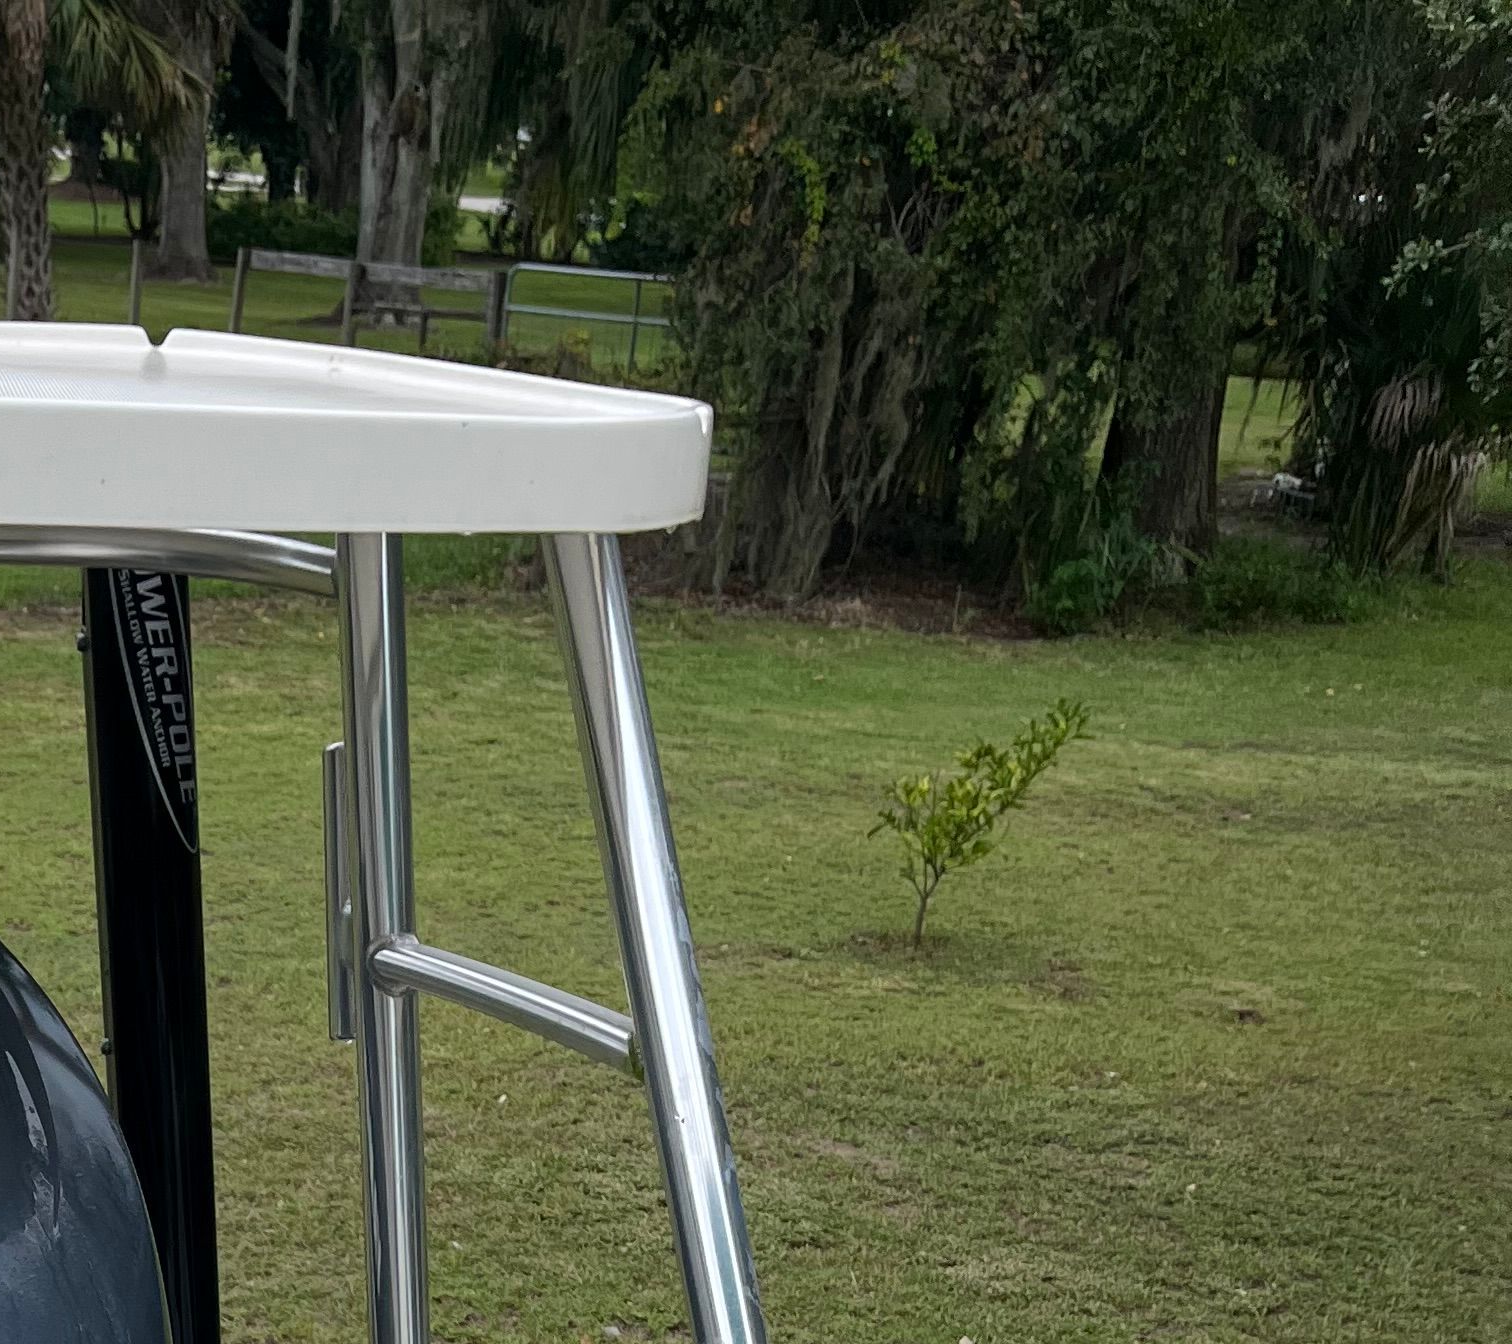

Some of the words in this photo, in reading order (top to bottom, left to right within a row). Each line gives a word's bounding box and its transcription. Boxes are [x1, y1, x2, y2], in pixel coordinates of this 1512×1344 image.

[134, 569, 197, 804] WER-POLE
[136, 648, 157, 703] WATER
[150, 706, 171, 768] ANCHOR
